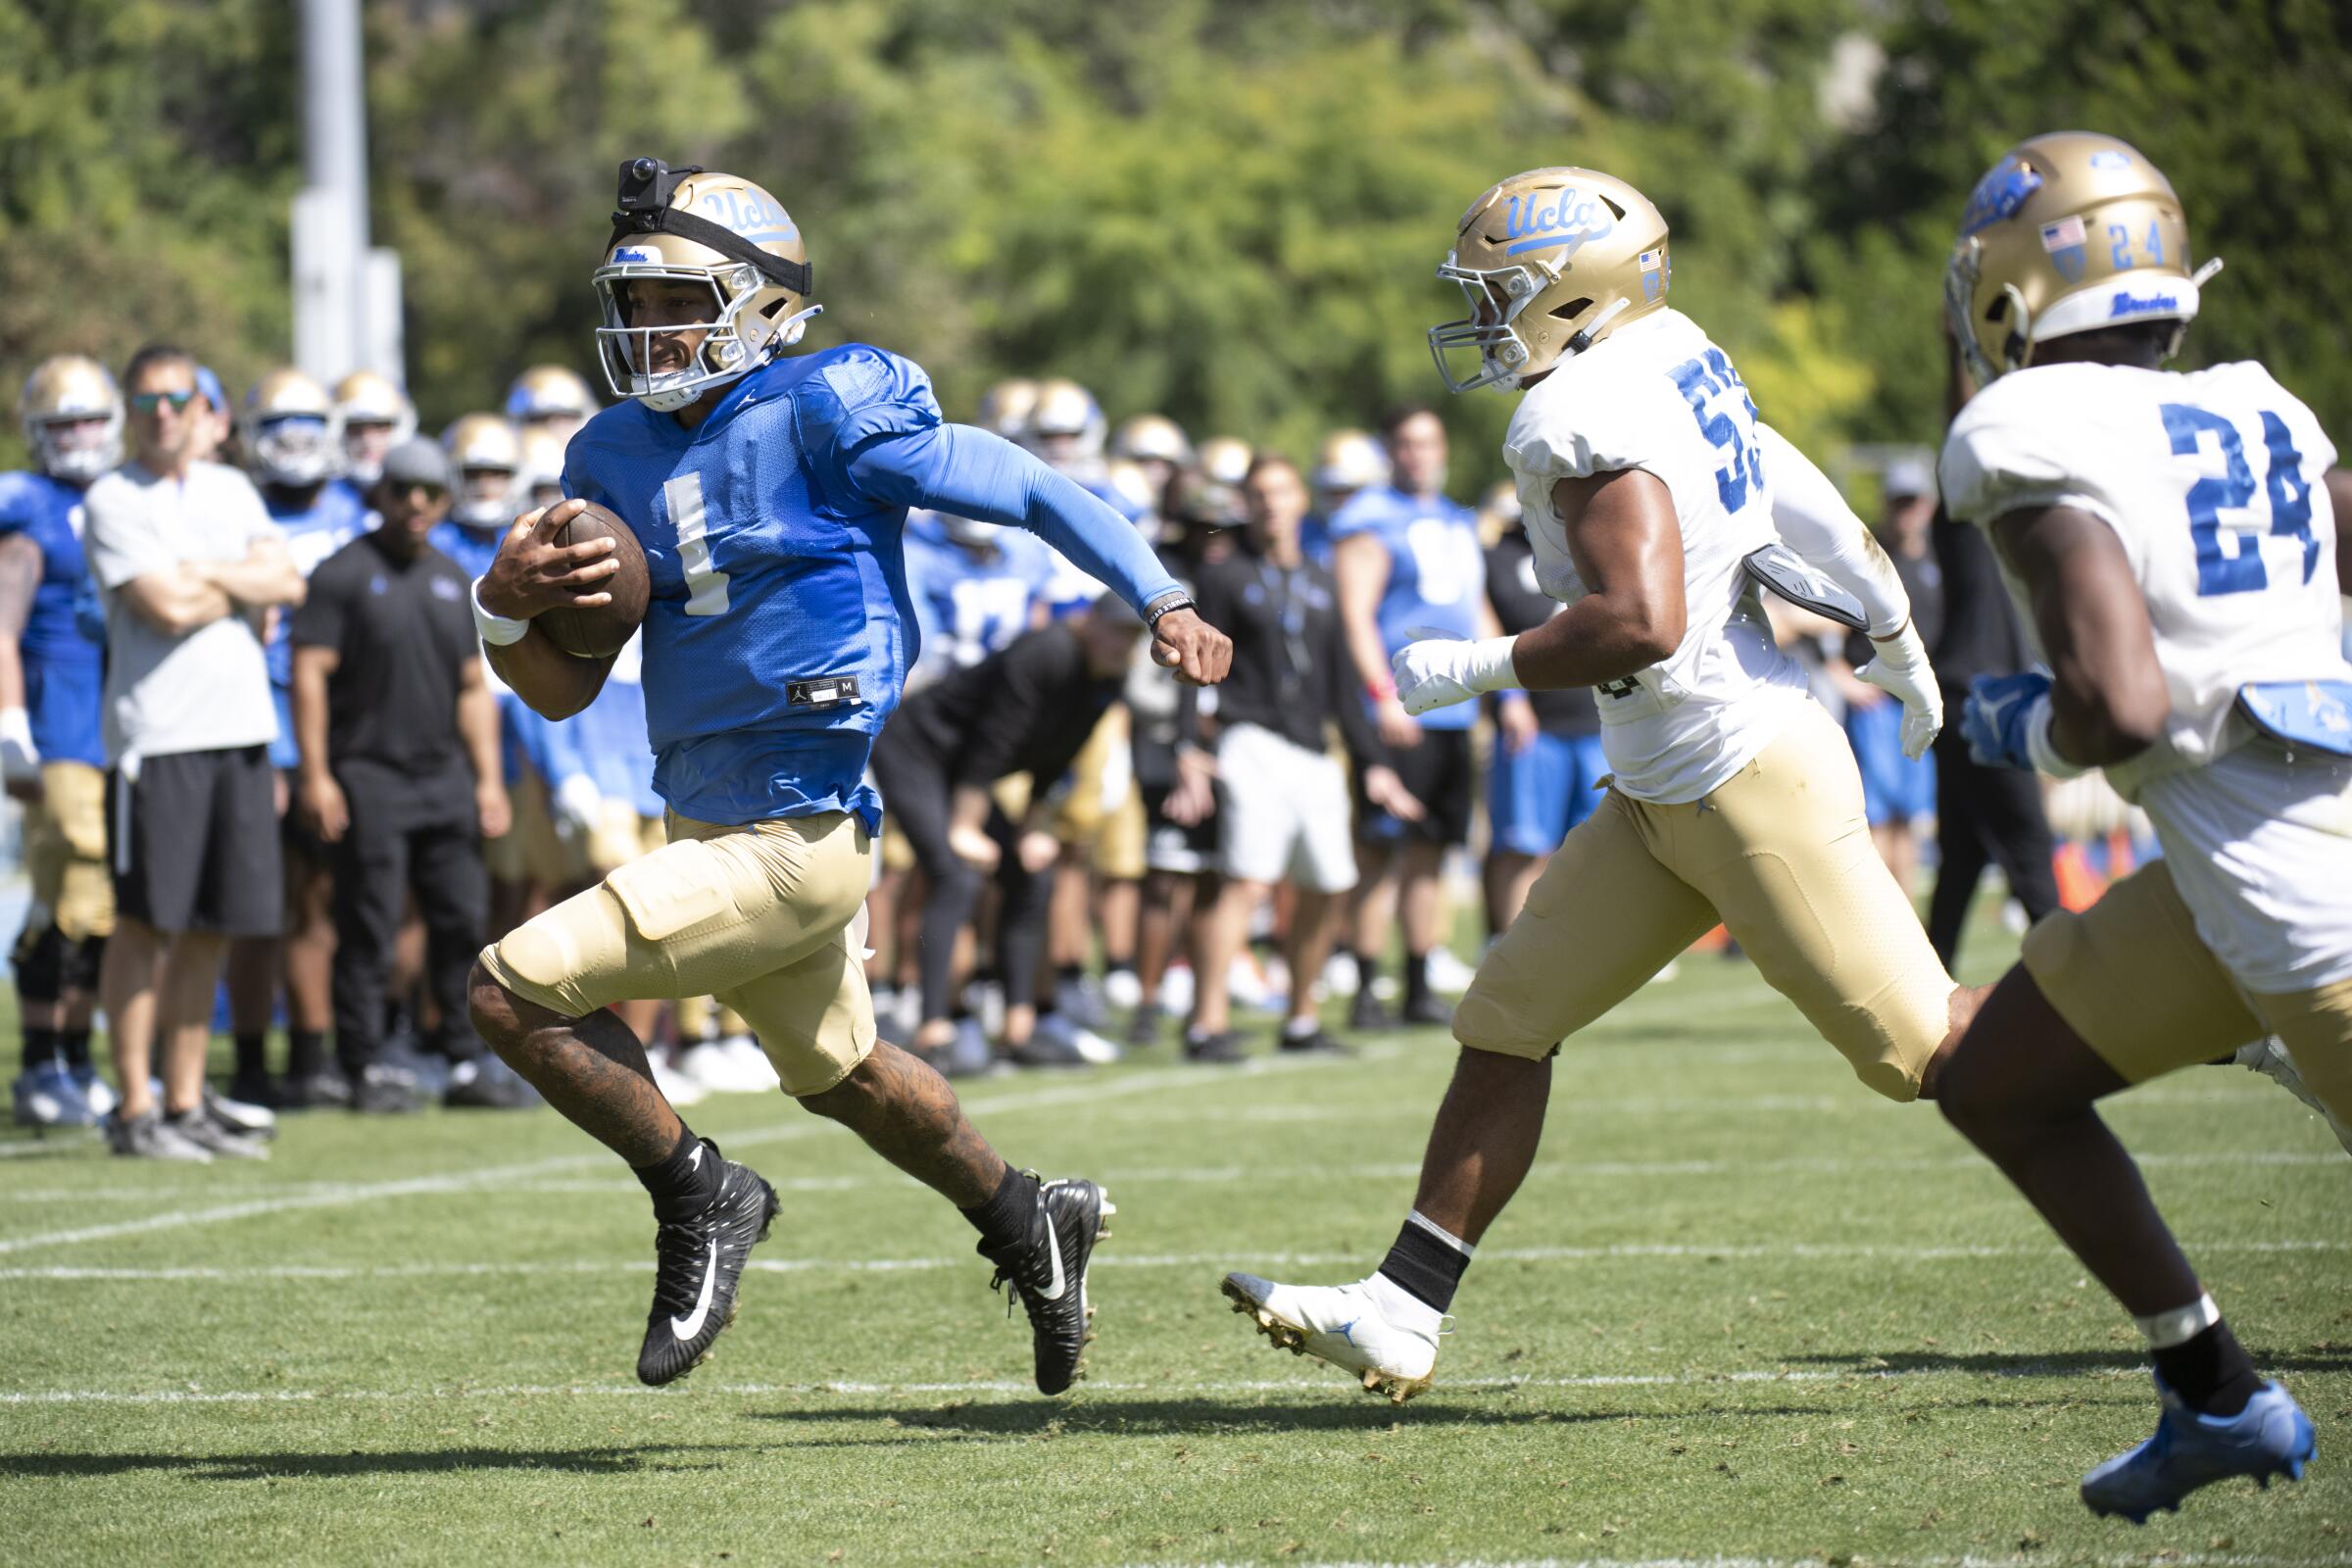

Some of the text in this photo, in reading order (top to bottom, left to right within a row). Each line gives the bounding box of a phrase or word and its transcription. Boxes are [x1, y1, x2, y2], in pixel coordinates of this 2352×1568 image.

[2108, 220, 2165, 270] 24
[2110, 292, 2178, 318] Bruins
[2159, 404, 2320, 596] 24
[663, 471, 730, 615] 1
[842, 682, 853, 692] M
